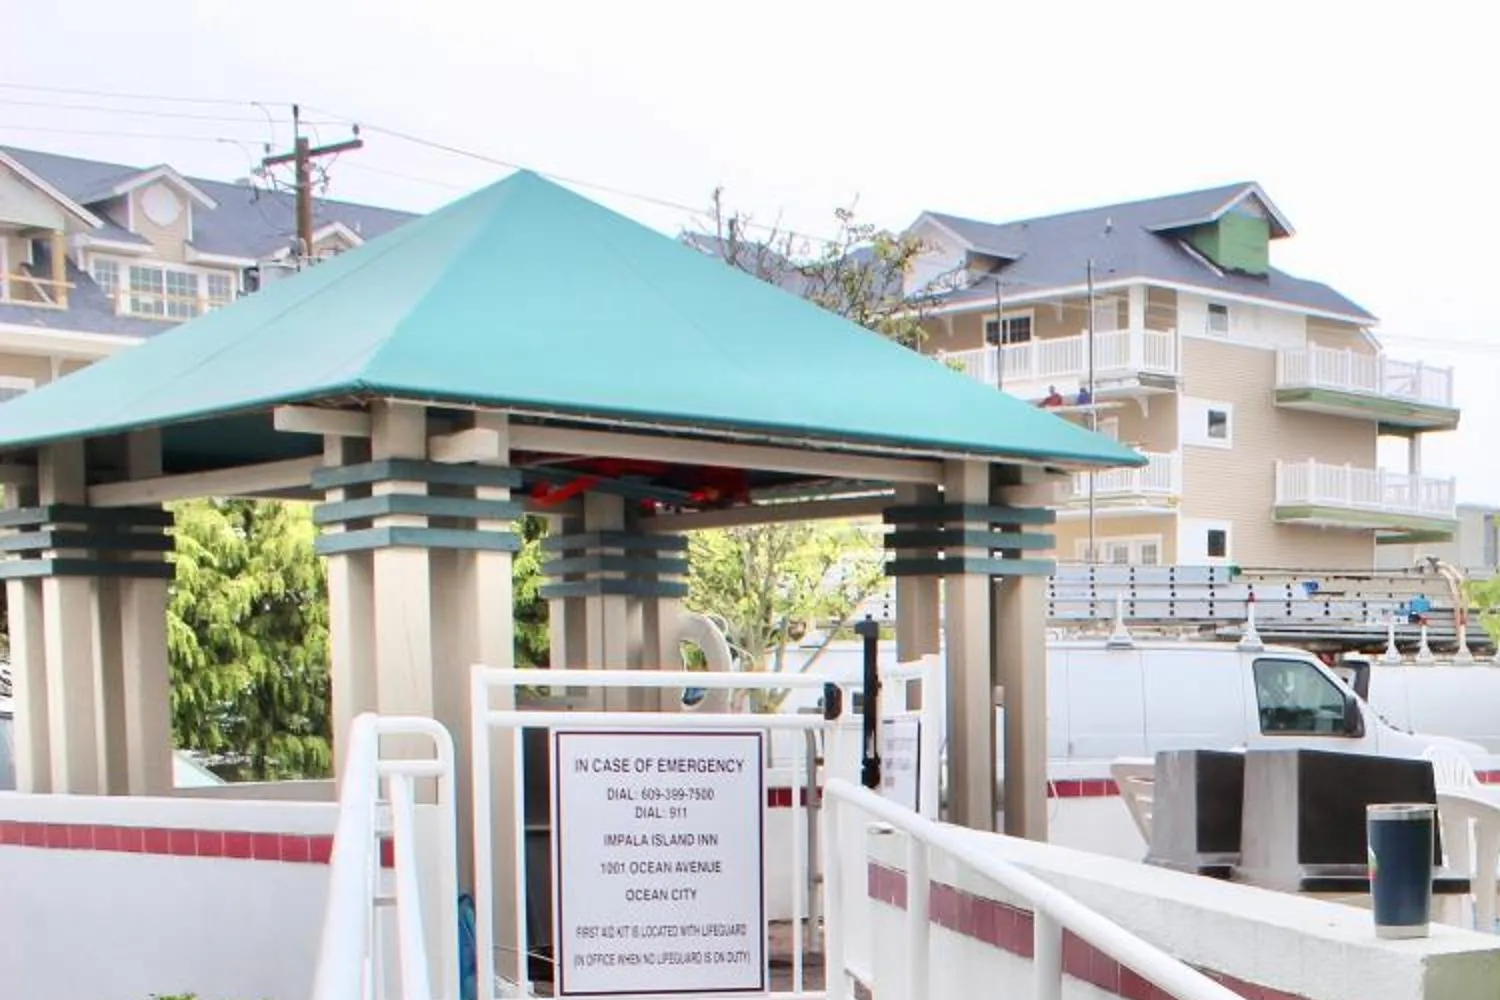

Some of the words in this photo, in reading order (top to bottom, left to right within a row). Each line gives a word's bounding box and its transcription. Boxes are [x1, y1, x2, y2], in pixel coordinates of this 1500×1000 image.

[575, 758, 589, 773] IN
[592, 758, 630, 773] CASE
[634, 758, 653, 773] OF
[657, 758, 745, 773] EMERGENCY
[635, 806, 665, 819] DIAL:
[669, 806, 688, 819] 911
[603, 834, 649, 847] IMPALA
[651, 833, 695, 846] ISLAND
[697, 833, 719, 846] INN
[600, 862, 625, 875] 1001
[629, 861, 672, 874] OCEAN
[675, 861, 722, 874] AVENUE
[625, 889, 668, 901] OCEAN
[671, 888, 698, 900] CITY
